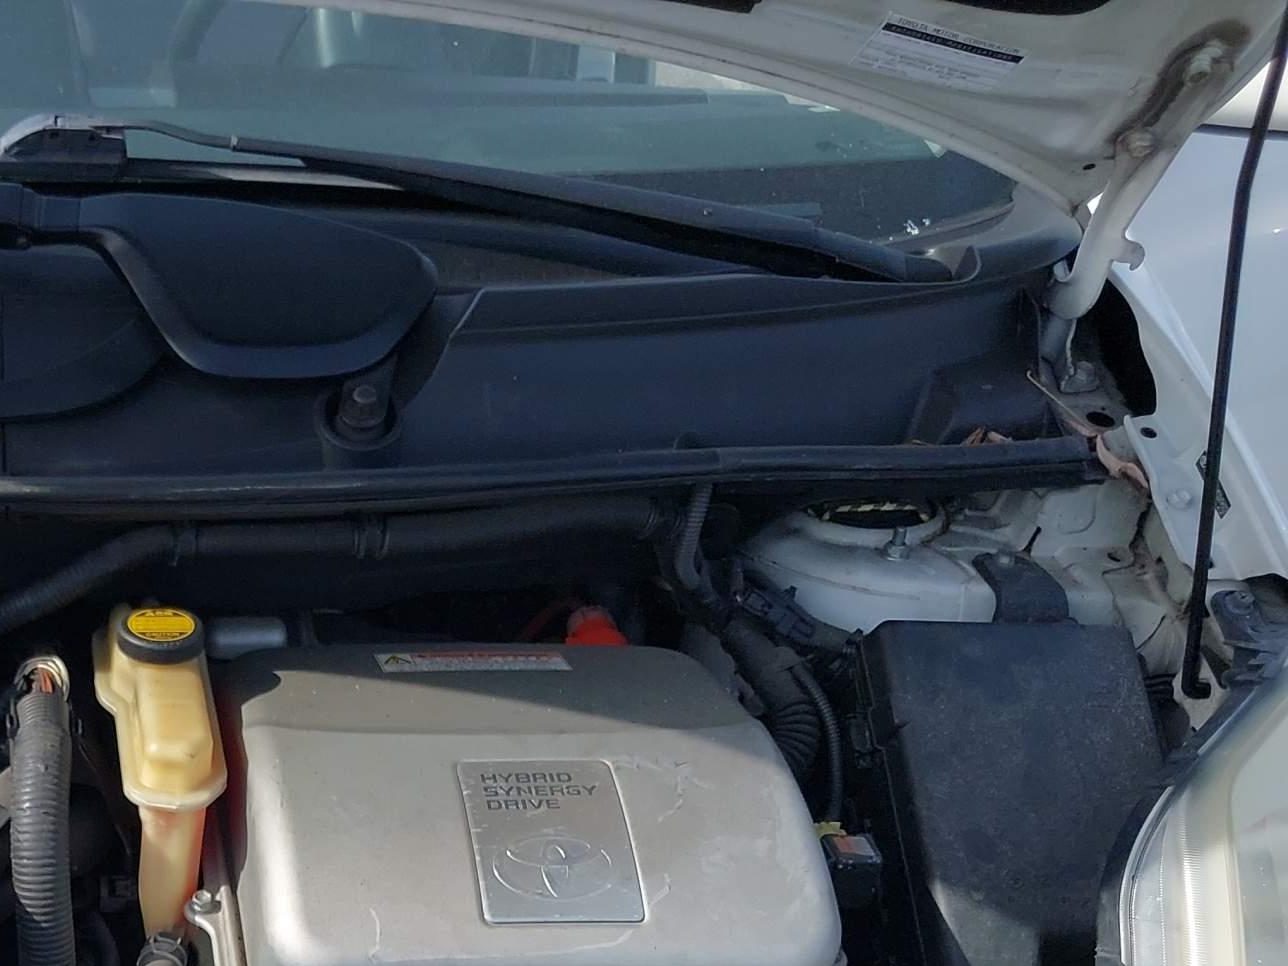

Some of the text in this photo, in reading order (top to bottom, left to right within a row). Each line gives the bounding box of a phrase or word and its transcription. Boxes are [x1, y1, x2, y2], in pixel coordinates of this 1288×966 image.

[480, 772, 573, 784] HYBRID
[483, 785, 597, 797] SYNERGY
[486, 798, 561, 811] DRIVE
